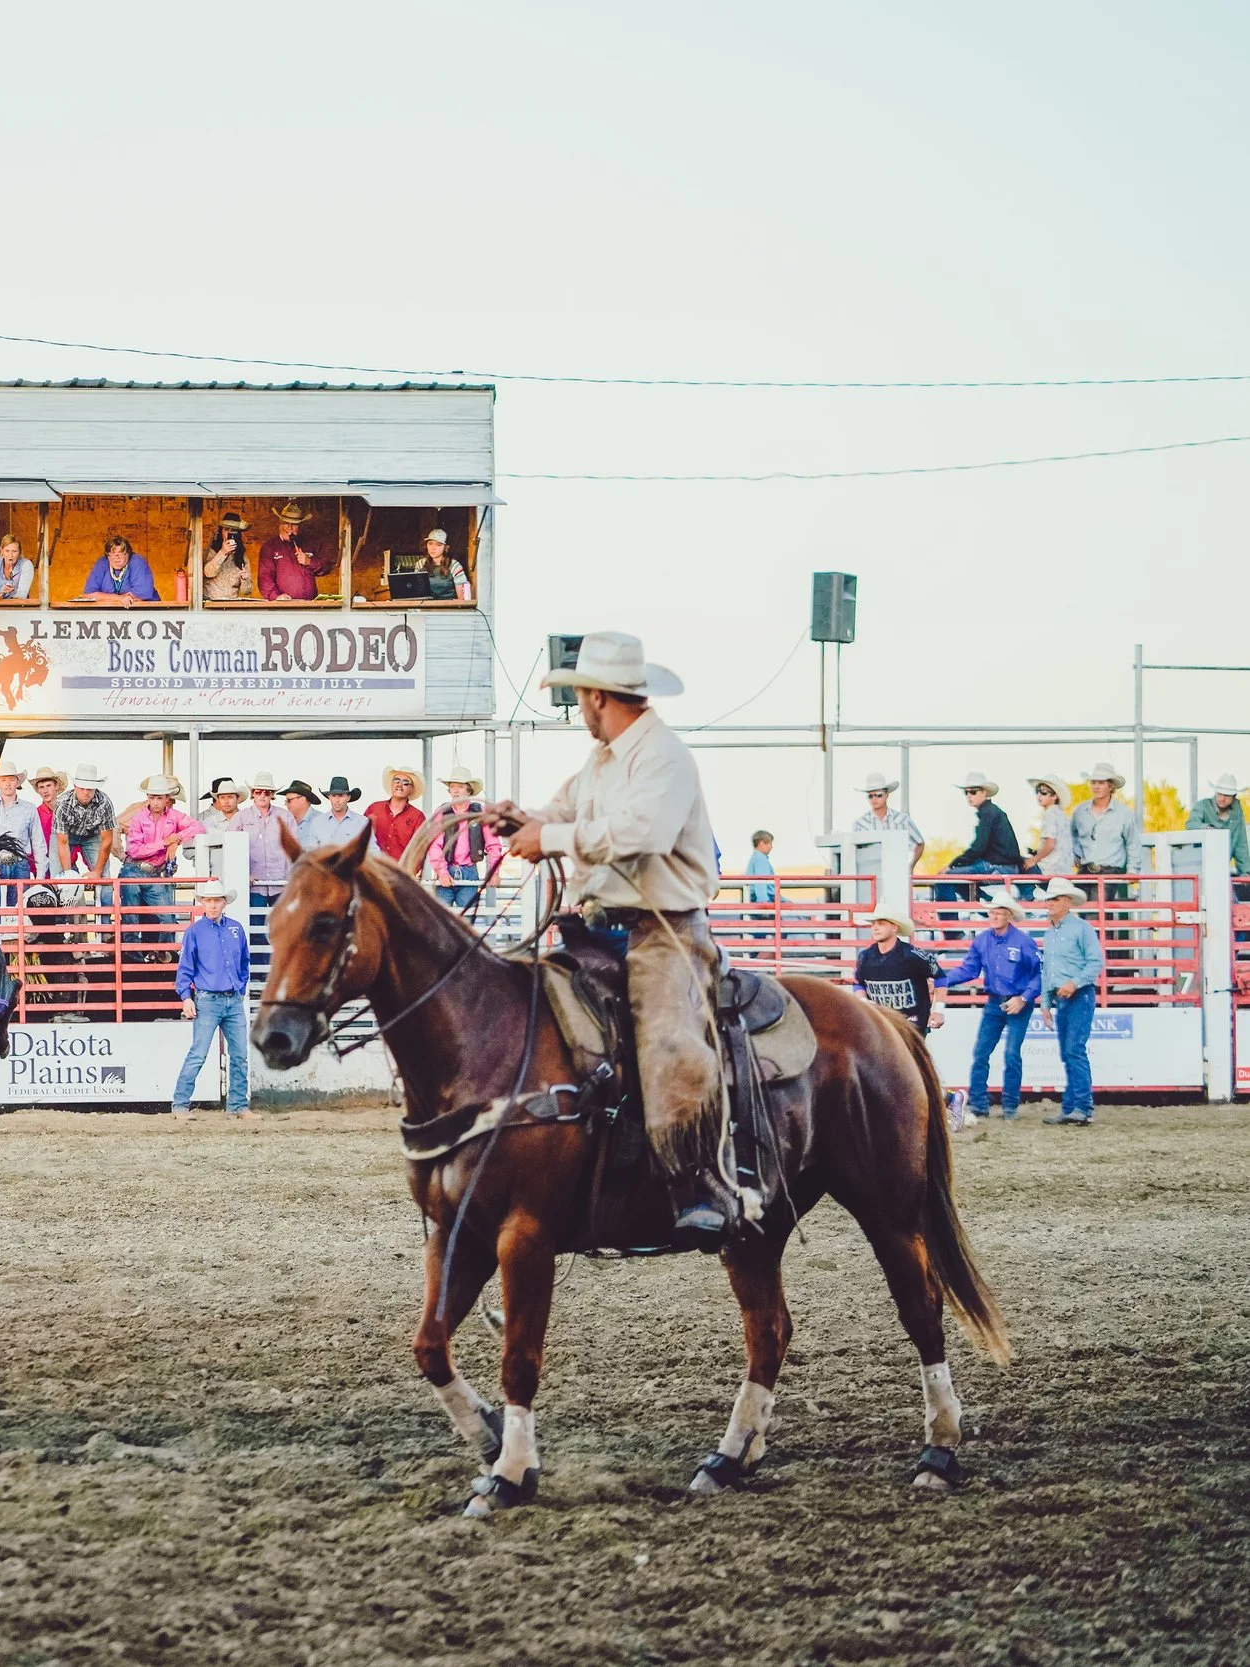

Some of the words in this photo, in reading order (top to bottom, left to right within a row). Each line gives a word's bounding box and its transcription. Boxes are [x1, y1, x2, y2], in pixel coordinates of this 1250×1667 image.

[30, 620, 185, 640] LEMMON
[108, 640, 155, 673] Boss
[169, 640, 258, 673] Cowman
[261, 624, 417, 672] RODEO
[111, 678, 183, 688] SECOND
[193, 678, 282, 688] WEEKEND
[292, 678, 310, 688] IN
[321, 678, 364, 689] JULY
[103, 688, 179, 713] Honoring
[287, 694, 331, 707] since
[339, 697, 371, 711] 1971
[1180, 972, 1194, 994] 7
[1091, 1019, 1118, 1031] ANK
[8, 1030, 113, 1057] Dakota
[8, 1058, 98, 1084] Plains
[8, 1087, 50, 1095] FEDERAL
[53, 1086, 90, 1095] CREDIT
[93, 1085, 126, 1095] UNION
